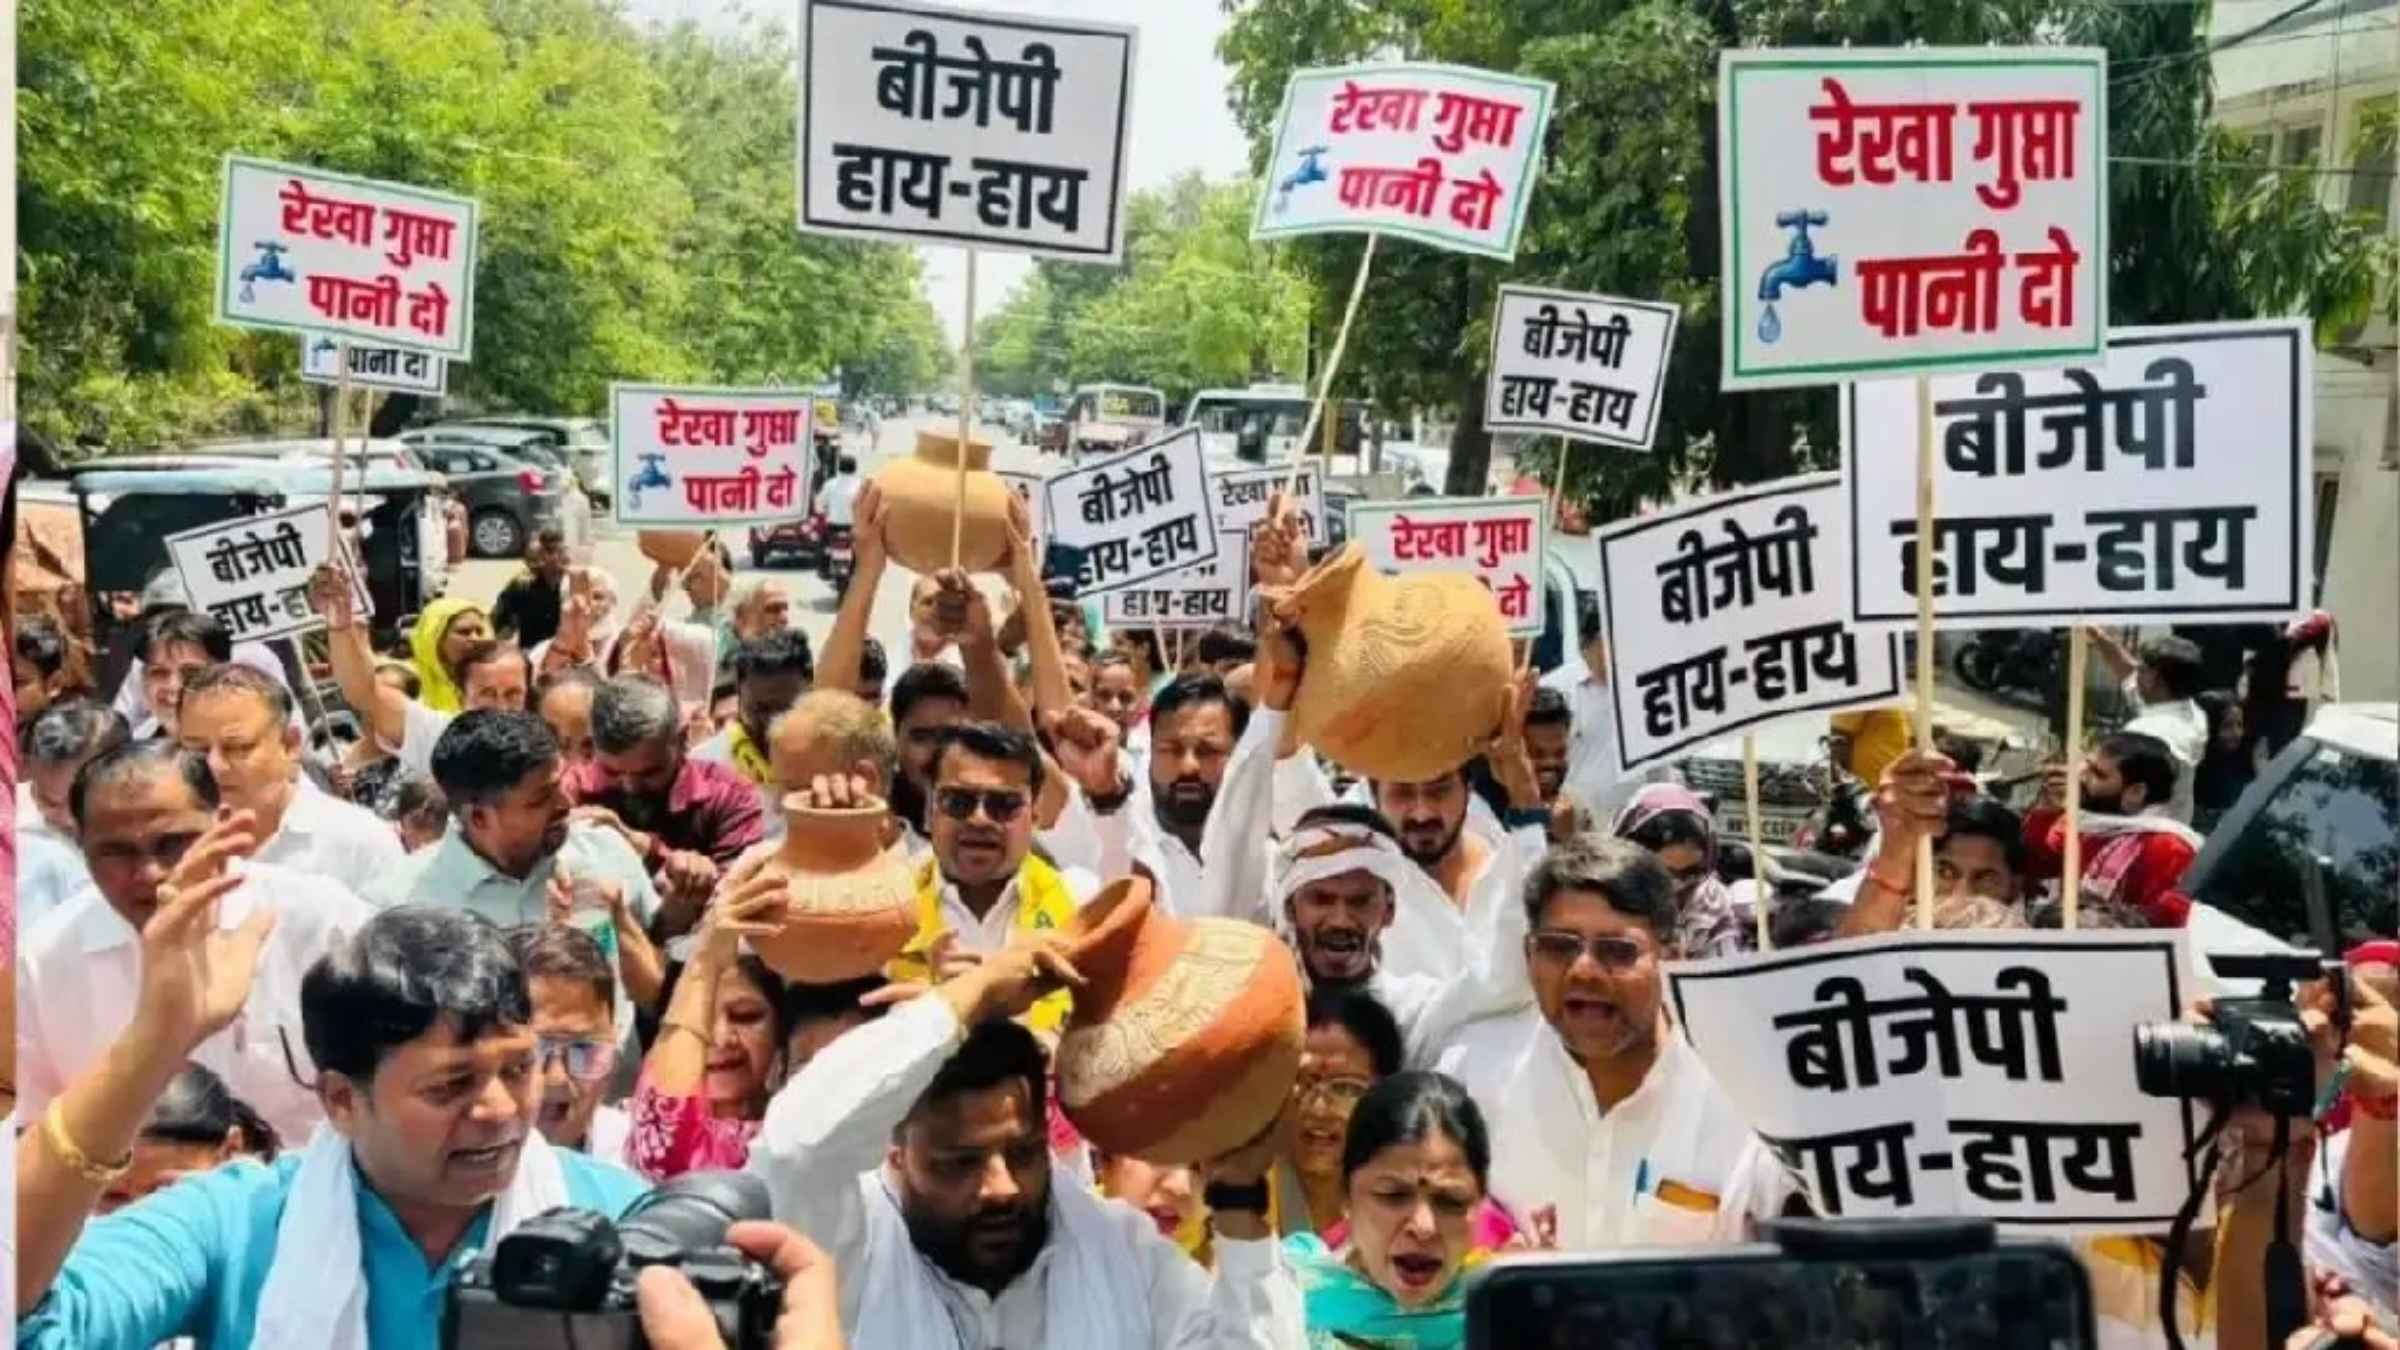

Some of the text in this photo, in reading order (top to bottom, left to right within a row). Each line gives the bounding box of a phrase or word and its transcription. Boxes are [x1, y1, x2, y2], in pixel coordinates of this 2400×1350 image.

[871, 29, 1062, 134] बीजेपी
[1330, 80, 1523, 154] रेखा गुप्ता
[1809, 77, 2080, 210] रेखा गुप्ता
[279, 180, 456, 267] रेखा गुप्ता
[832, 143, 1088, 232] हाय-हाय
[1339, 157, 1502, 230] पानी दो
[306, 274, 449, 336] पानी दो
[1856, 226, 2079, 337] पानी दो
[1523, 304, 1632, 369] बीजेपी
[656, 398, 800, 458] रेखा गुप्ता
[1501, 374, 1638, 430] हाय-हाय
[1935, 357, 2205, 477] बीजेपी
[682, 465, 796, 511] पानी दो
[1078, 452, 1173, 524] बीजेपी
[1219, 478, 1267, 506] रेखा
[206, 522, 307, 582] बीजेपी
[1391, 514, 1532, 568] रेखा गुप्ता
[1656, 505, 1818, 624] बीजेपी
[1890, 505, 2257, 597] हाय-हाय
[206, 585, 311, 633] हाय-ह
[1496, 573, 1530, 616] दो
[1636, 621, 1857, 737] हाय-हाय
[1773, 966, 2067, 1092] बीजेपी
[1764, 1119, 2142, 1214] ाय-हाय
